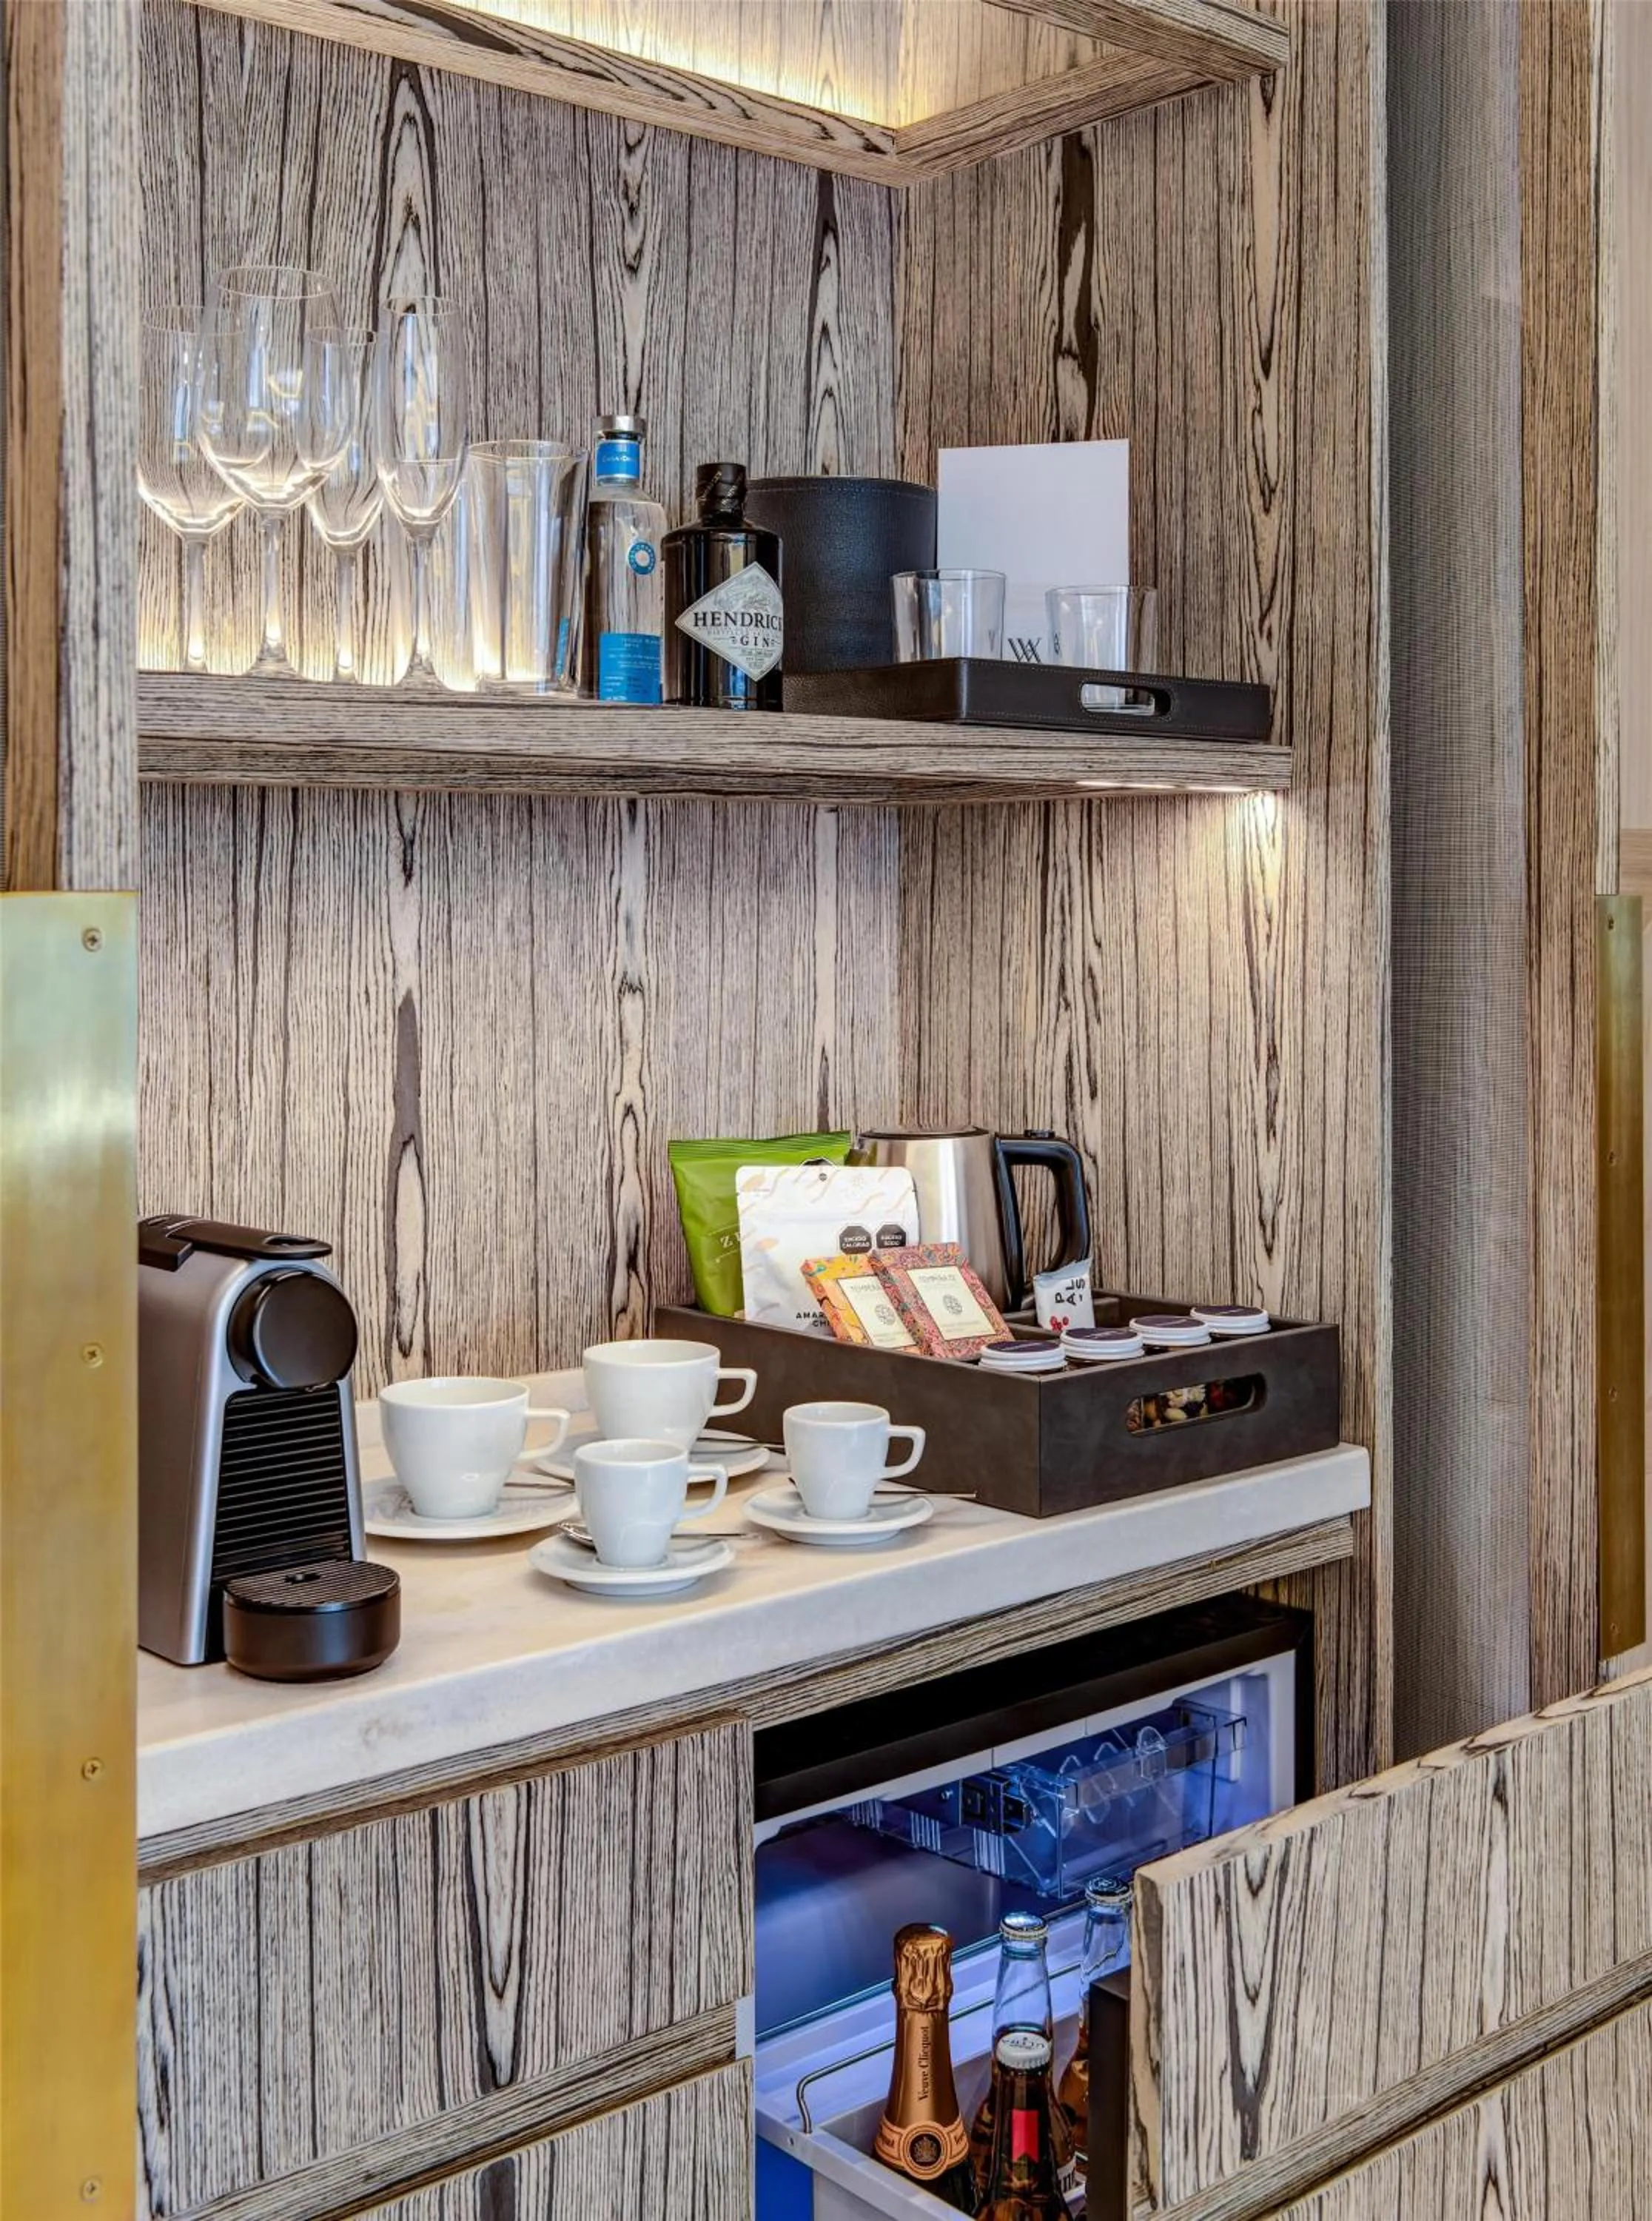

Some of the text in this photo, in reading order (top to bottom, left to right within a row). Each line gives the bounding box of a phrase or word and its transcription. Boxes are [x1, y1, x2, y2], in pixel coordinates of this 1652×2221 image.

[740, 636, 770, 648] GIN
[917, 2026, 932, 2101] Veuve Clicquot
